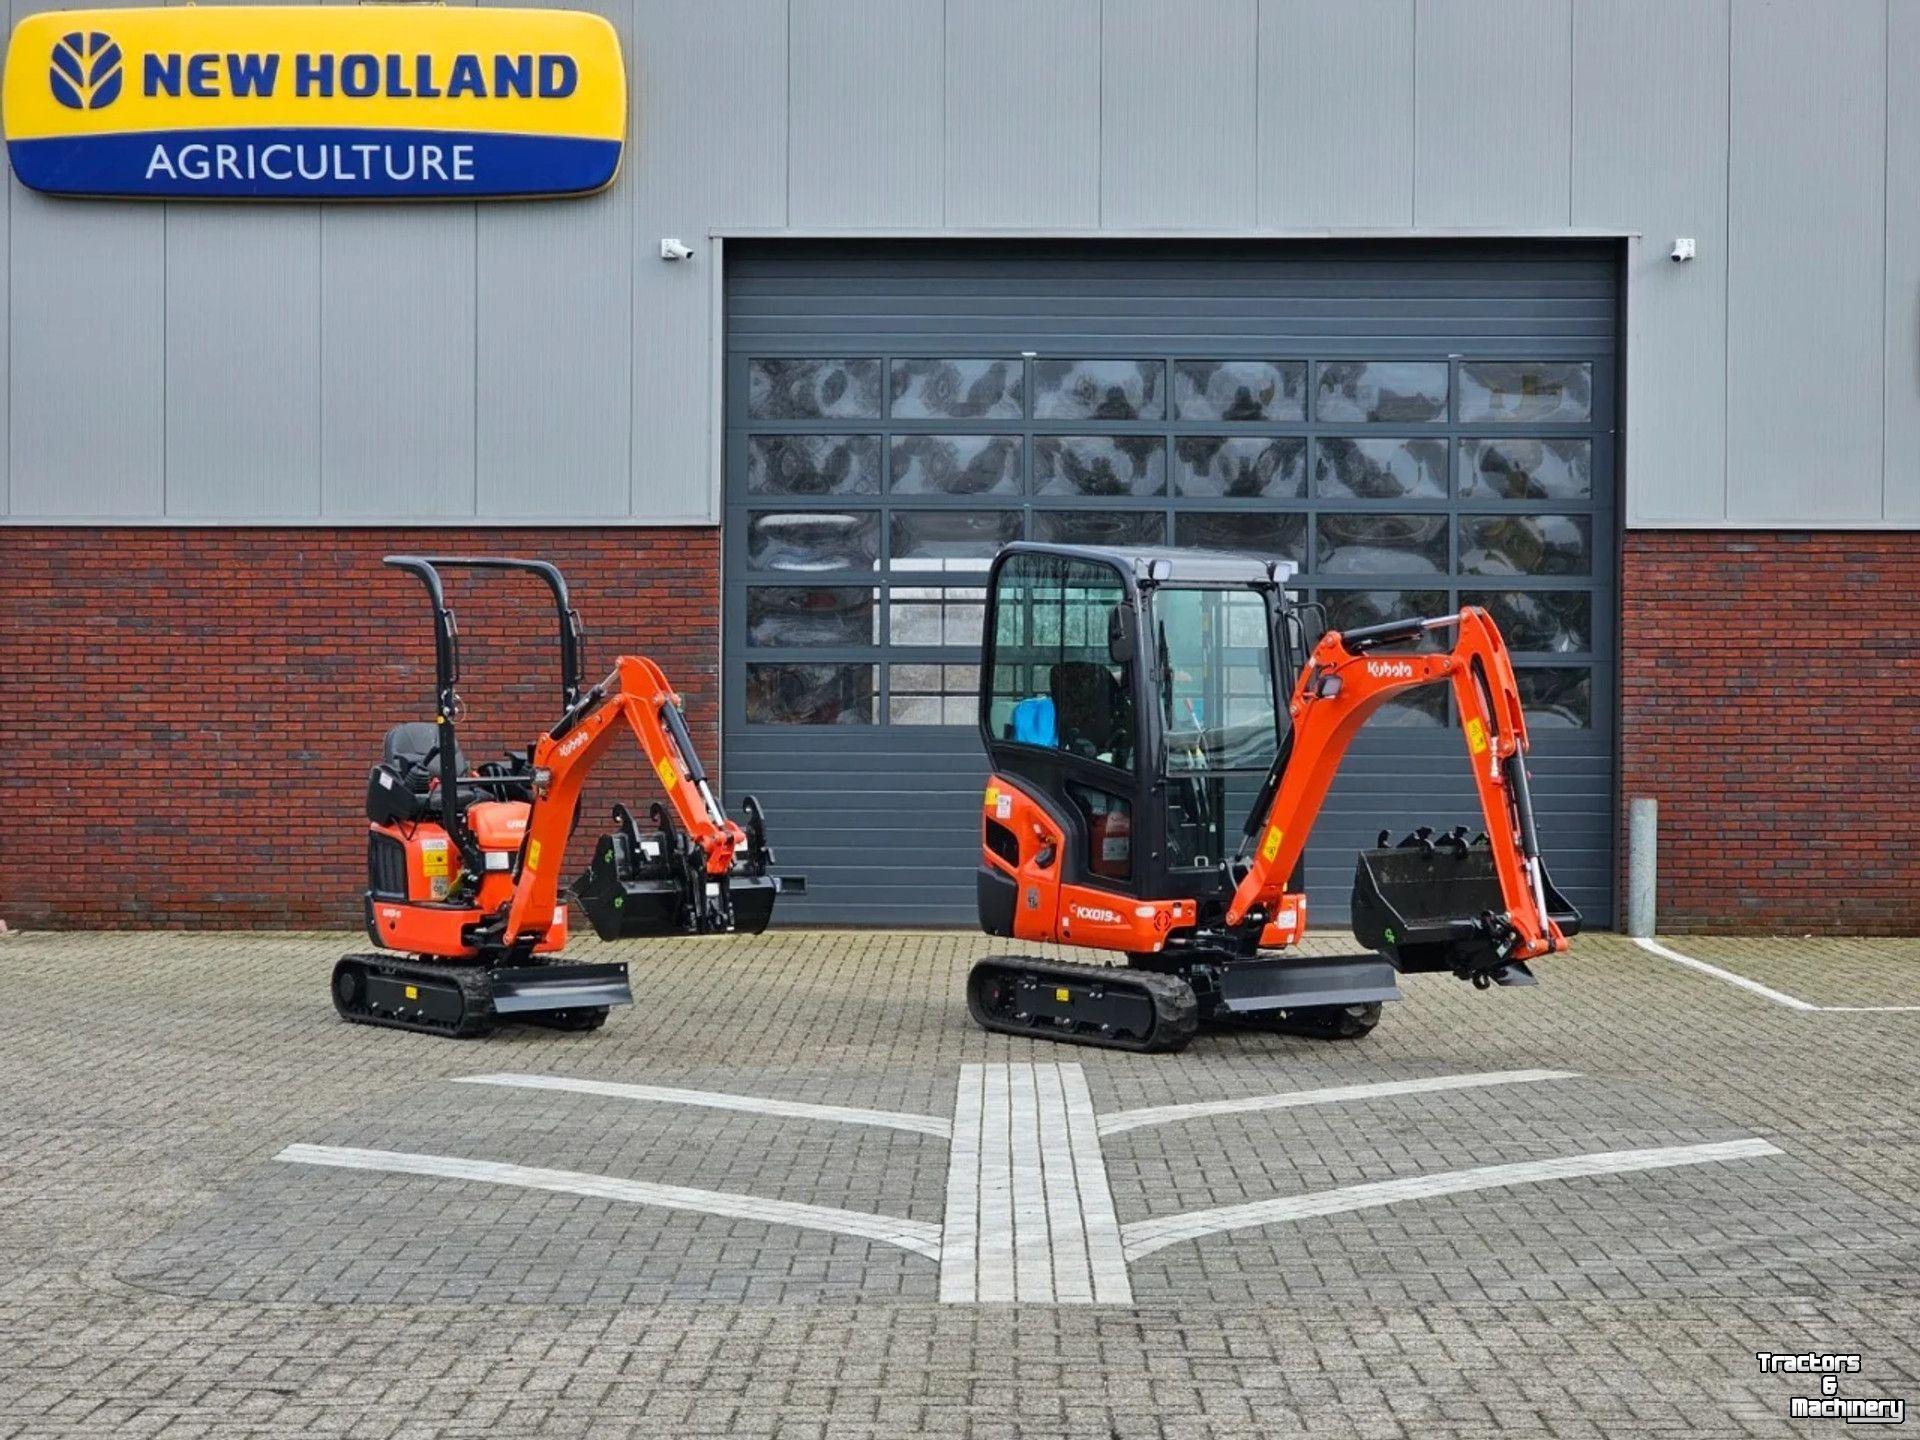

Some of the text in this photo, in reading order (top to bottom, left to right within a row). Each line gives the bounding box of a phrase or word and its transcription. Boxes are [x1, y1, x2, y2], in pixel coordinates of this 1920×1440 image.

[144, 53, 578, 98] NEW HOLLAND
[145, 144, 475, 181] AGRICULTURE
[1367, 661, 1412, 677] Kubota
